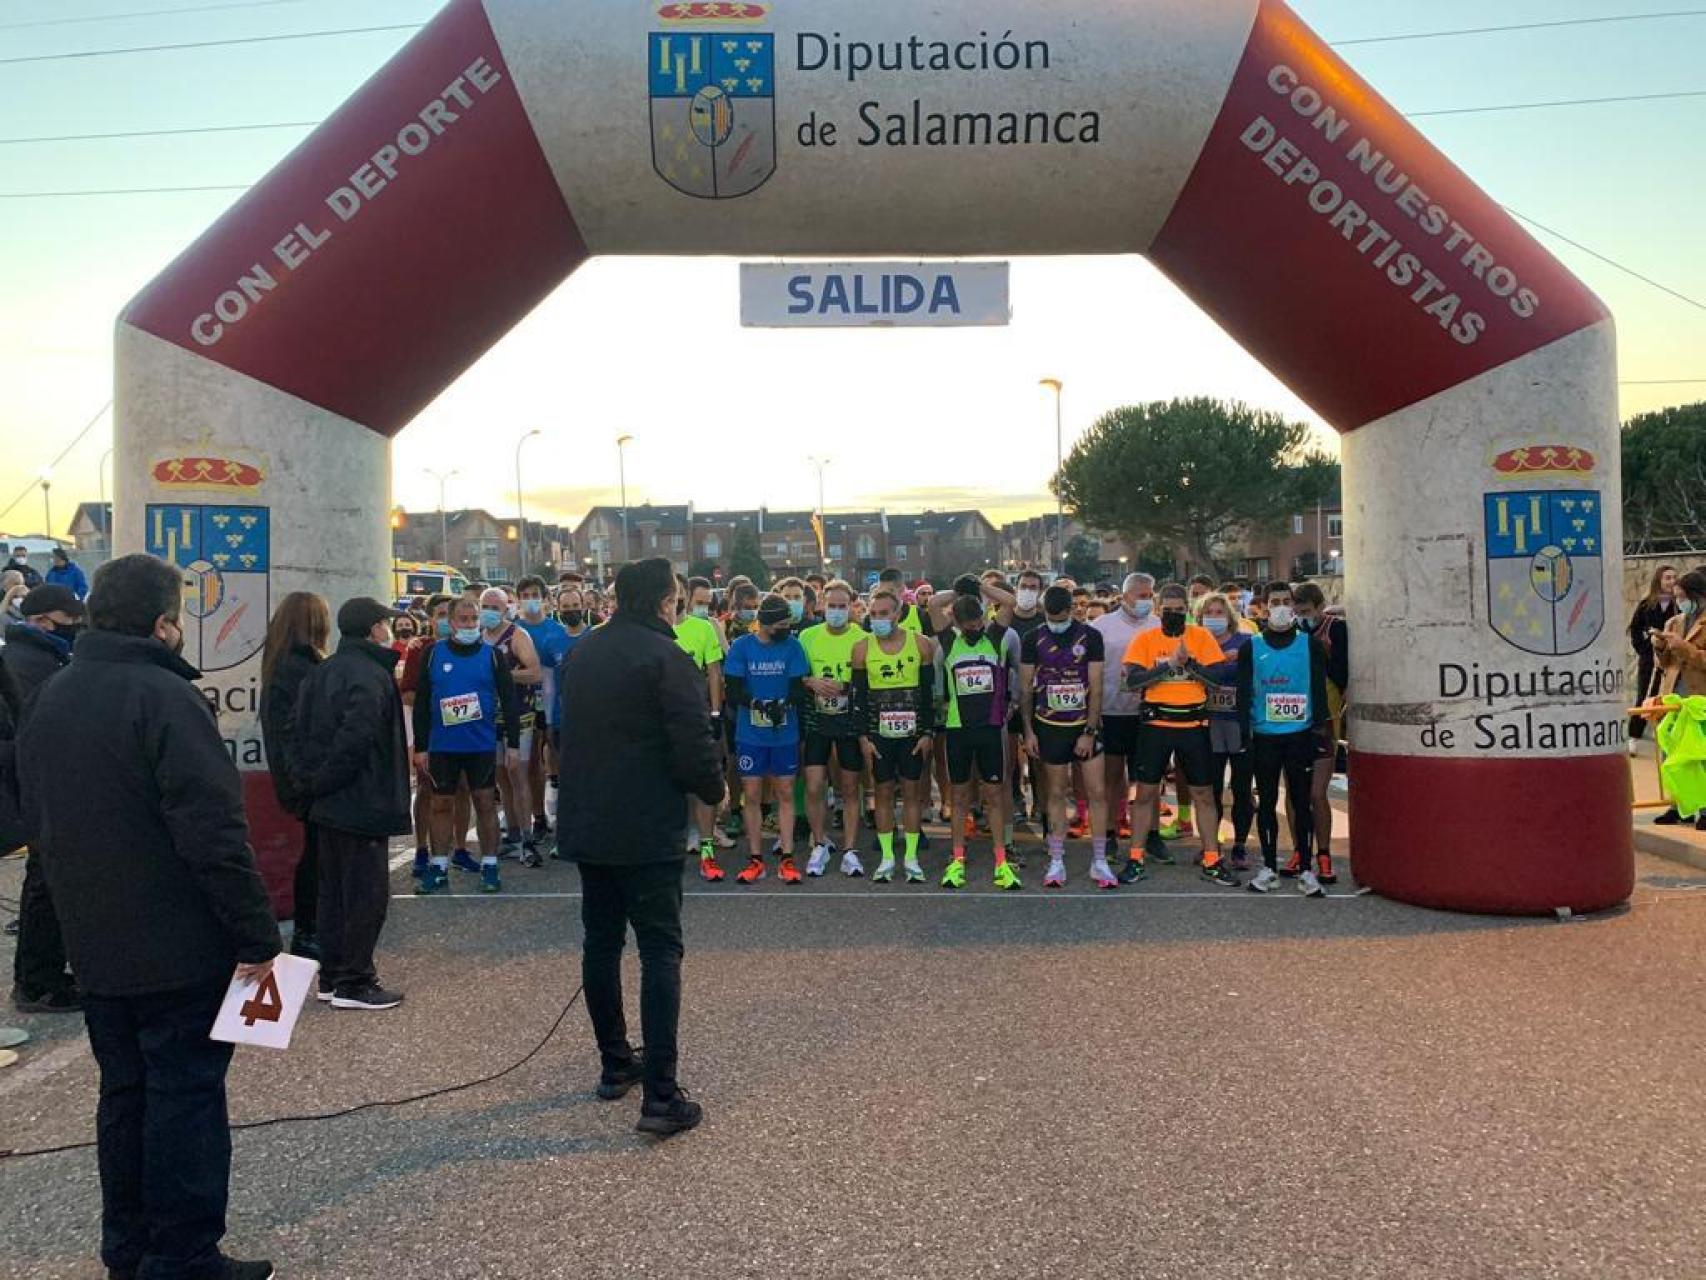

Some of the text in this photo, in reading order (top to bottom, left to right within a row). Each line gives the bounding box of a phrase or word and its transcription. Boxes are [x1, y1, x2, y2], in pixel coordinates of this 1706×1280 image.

[797, 30, 1049, 82] Diputación
[797, 98, 1100, 147] de Salamanca
[190, 56, 502, 347] CON EL DEPORTE
[1267, 64, 1540, 319] CON NUESTROS
[1239, 115, 1486, 345] DEPORTISTAS
[787, 274, 960, 314] SALIDA
[452, 704, 468, 718] 97
[823, 697, 839, 708] 28
[1055, 694, 1079, 704] 196
[1274, 704, 1299, 716] 200
[887, 721, 909, 731] 155
[1420, 722, 1456, 749] de
[240, 970, 283, 1027] 4
